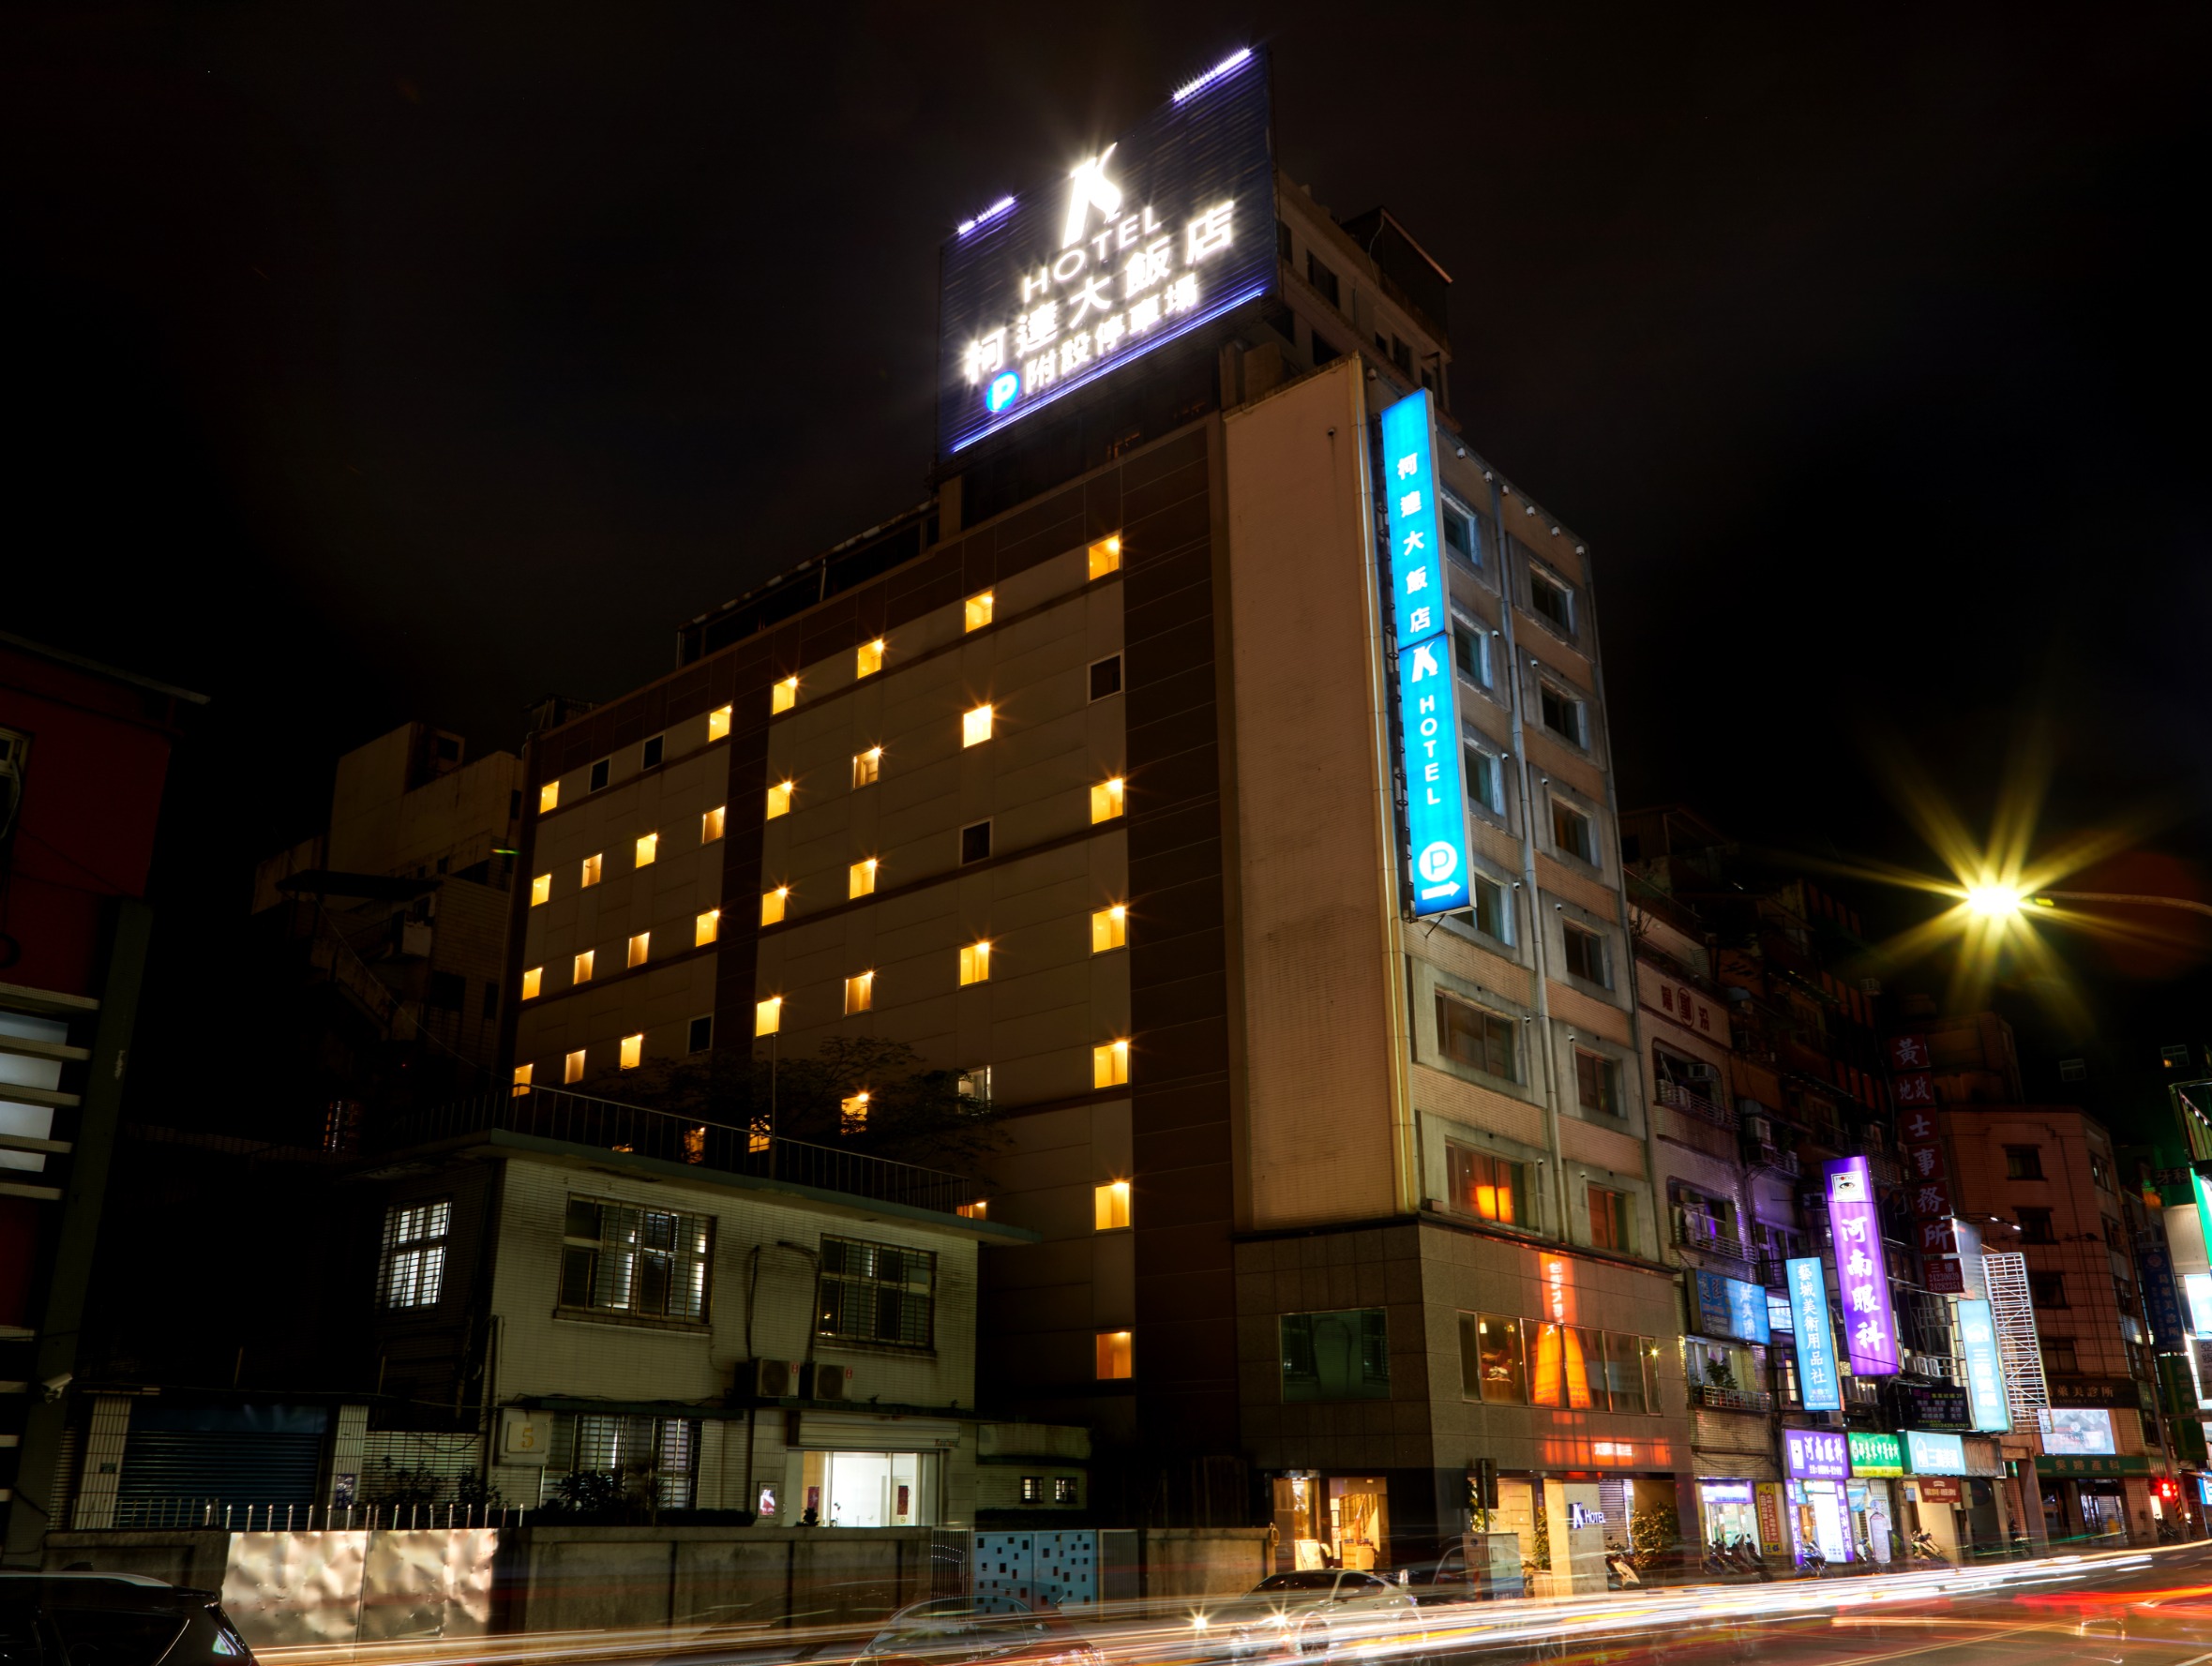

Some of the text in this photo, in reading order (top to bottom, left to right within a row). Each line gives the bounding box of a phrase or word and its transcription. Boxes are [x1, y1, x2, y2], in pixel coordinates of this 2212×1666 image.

[963, 200, 1236, 384] 柯達大飯店
[1022, 205, 1162, 303] HOTEL
[1397, 452, 1431, 634] 柯達大飯店
[1420, 694, 1441, 805] HOTEL
[1797, 1263, 1828, 1385] 藝城美術用品社
[1841, 1216, 1886, 1352] 河南眼科
[521, 1427, 534, 1448] 5
